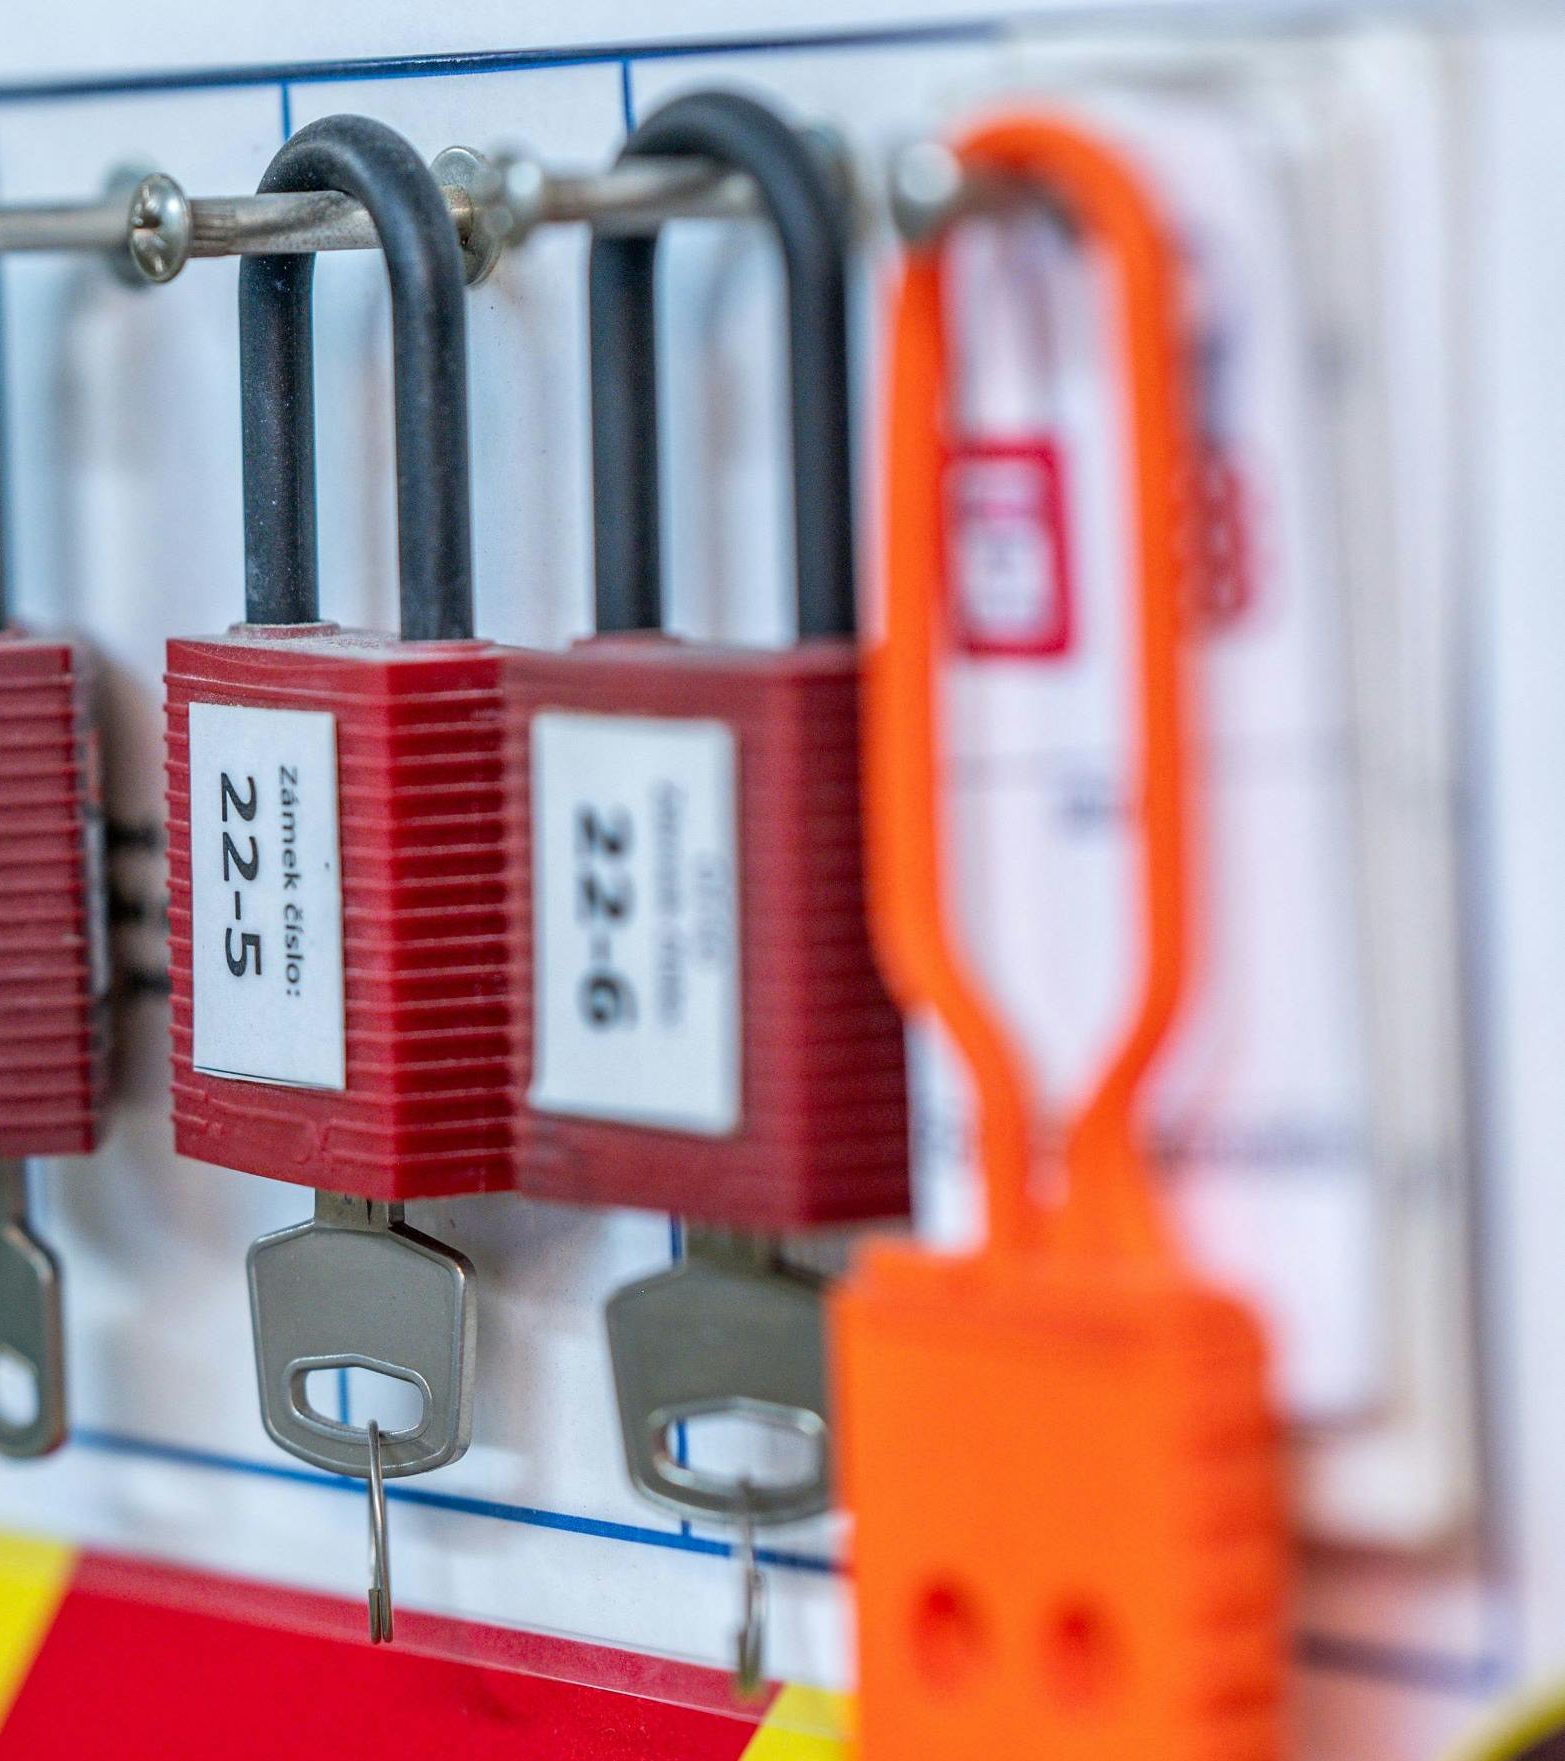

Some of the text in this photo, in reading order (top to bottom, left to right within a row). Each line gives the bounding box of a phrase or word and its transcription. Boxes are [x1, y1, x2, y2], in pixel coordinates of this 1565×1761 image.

[220, 771, 262, 978] 22-5
[278, 764, 305, 997] Zámek číslo:
[574, 802, 639, 1032] 22-6
